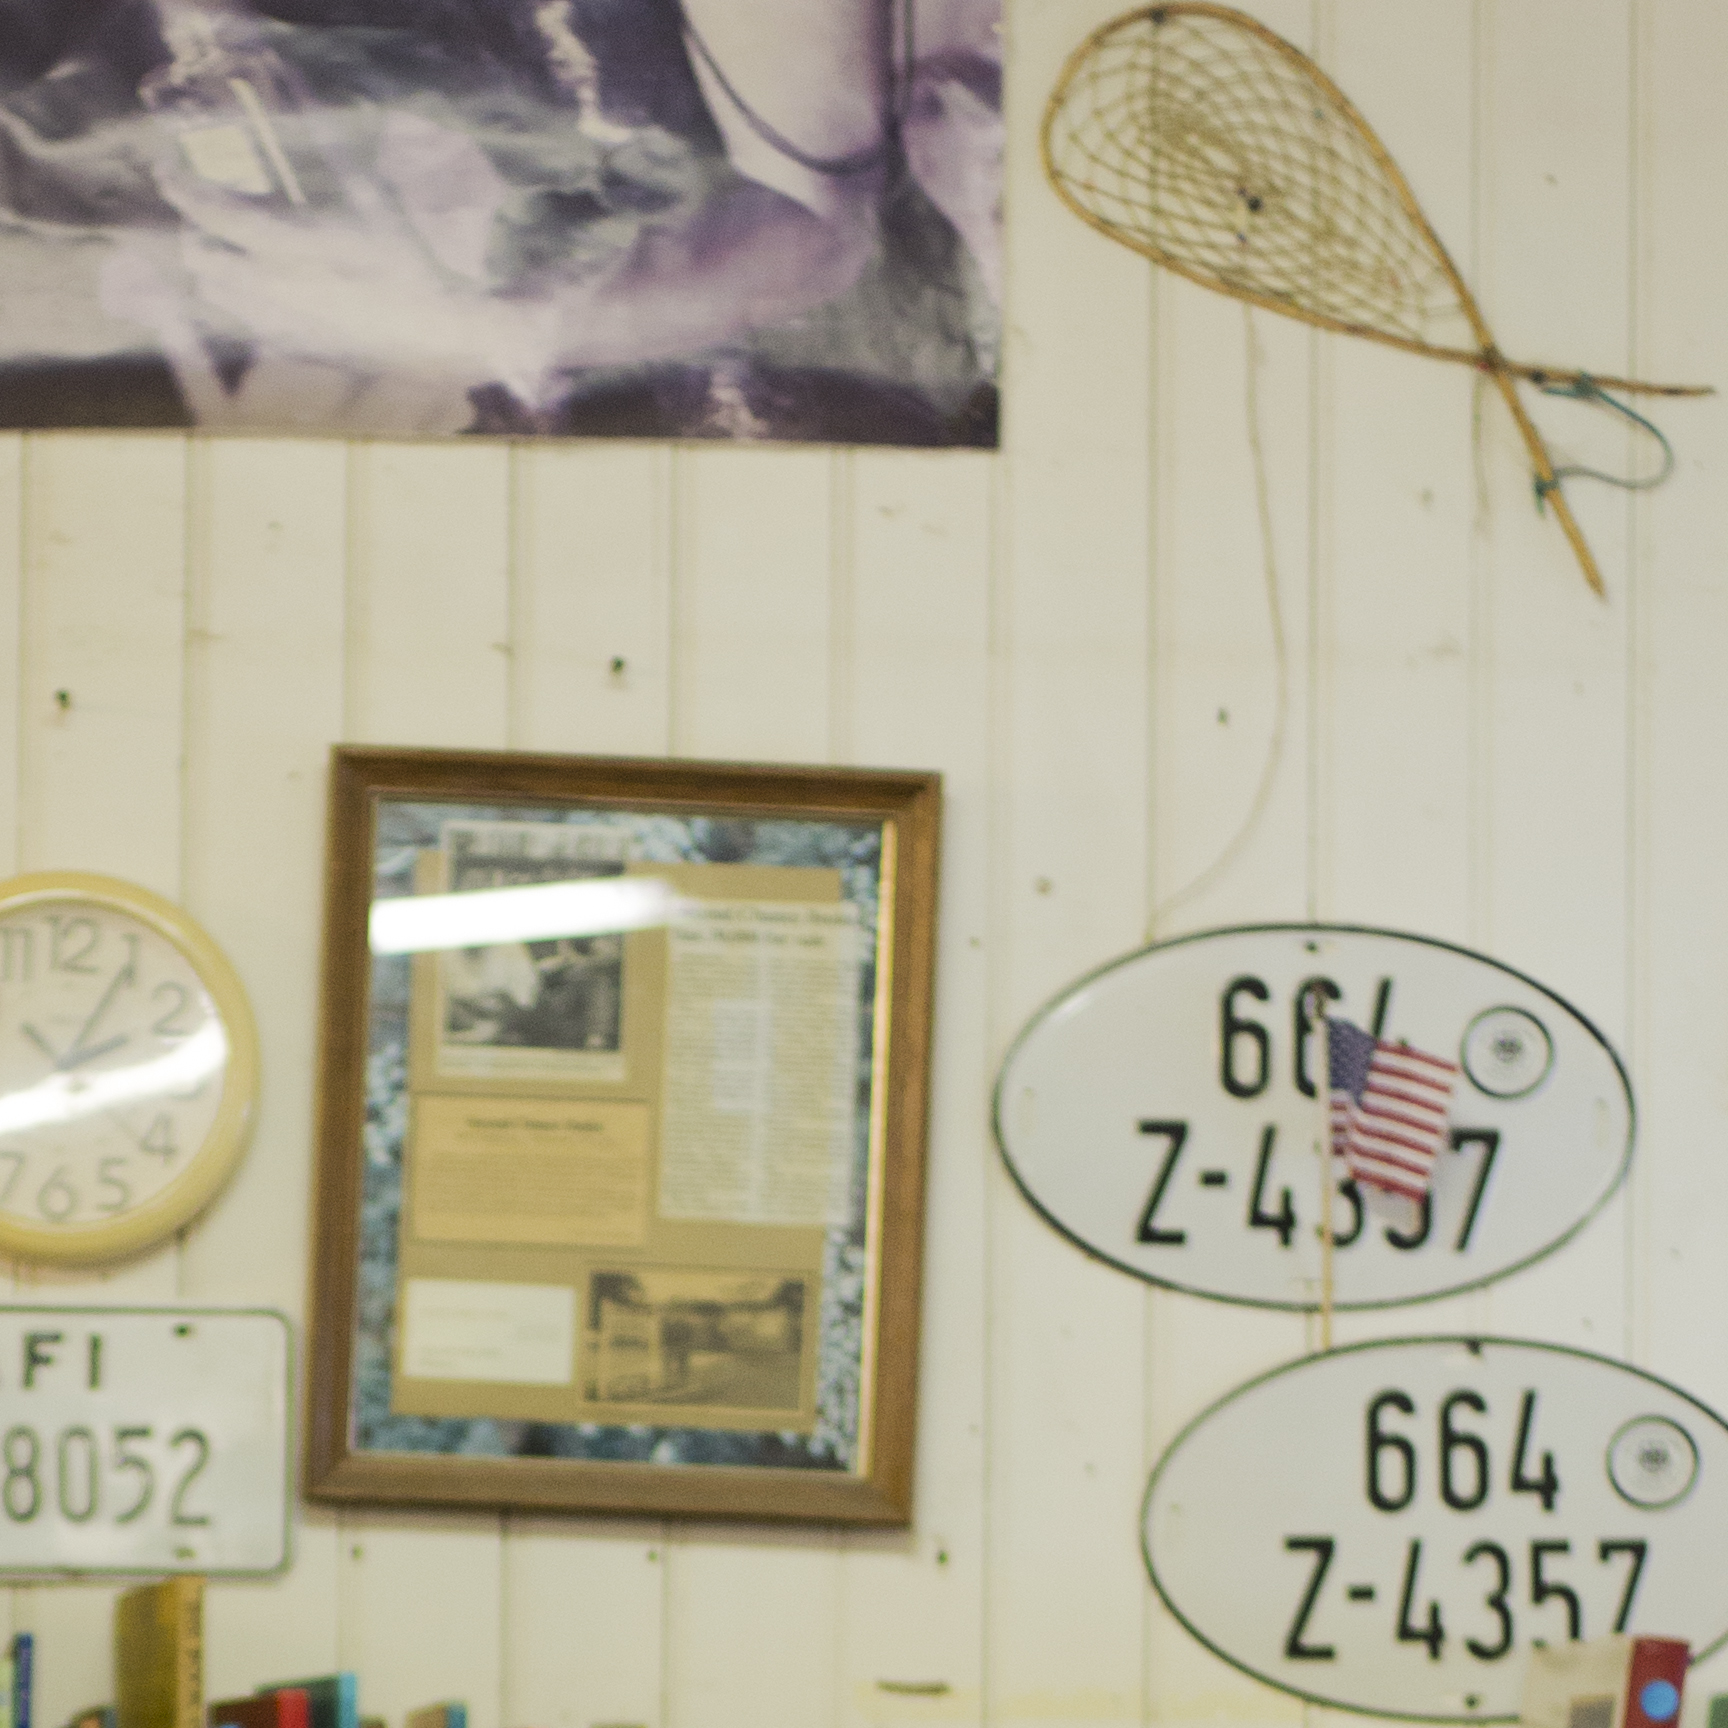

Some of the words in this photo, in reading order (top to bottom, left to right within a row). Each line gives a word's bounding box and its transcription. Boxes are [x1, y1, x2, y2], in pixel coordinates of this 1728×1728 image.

[46, 914, 100, 974] 12
[150, 981, 188, 1038] 2
[140, 1113, 177, 1166] 4
[37, 1166, 79, 1224] 6
[95, 1157, 131, 1213] 5
[1363, 1388, 1560, 1513] 664
[1283, 1535, 1649, 1662] Z-4357
